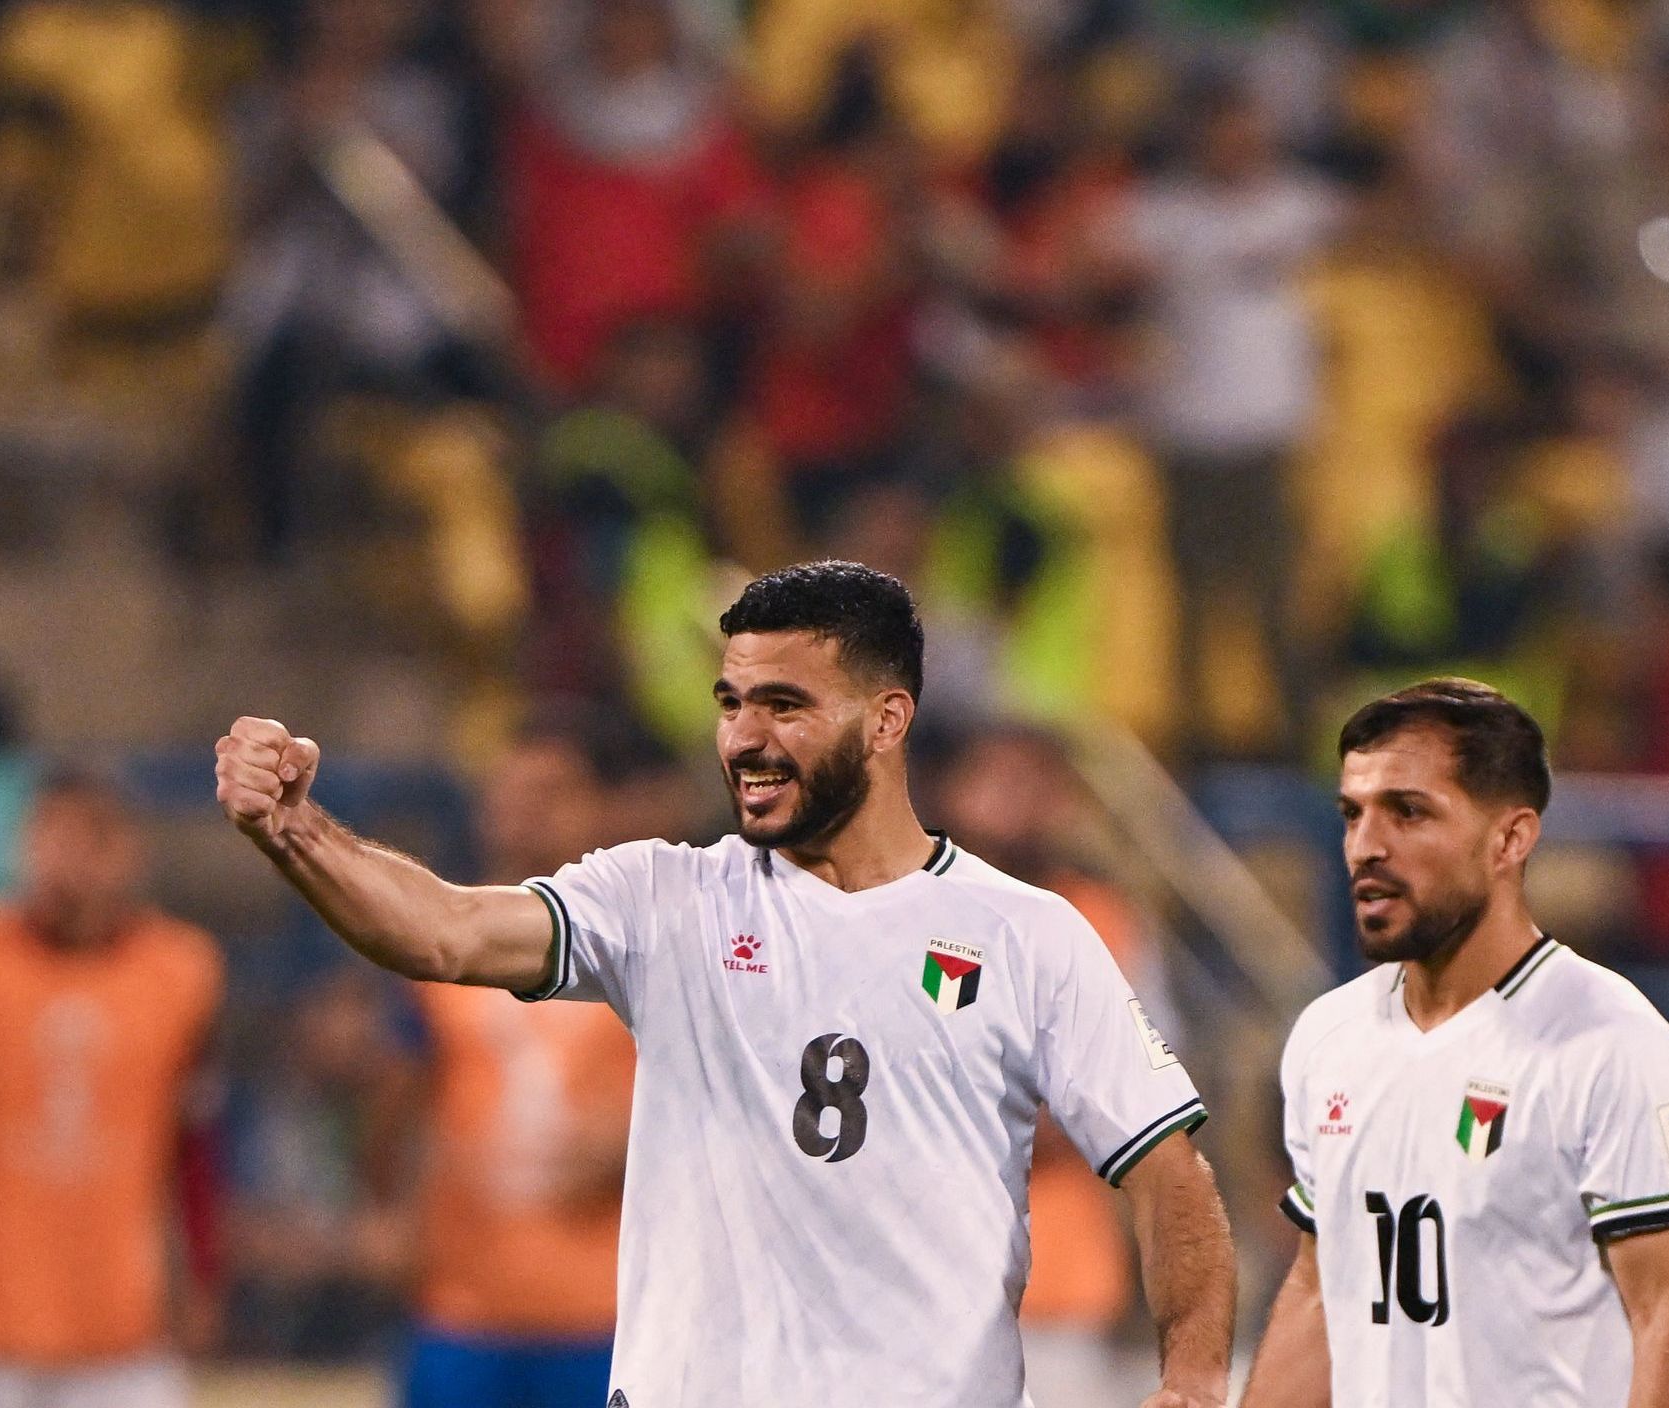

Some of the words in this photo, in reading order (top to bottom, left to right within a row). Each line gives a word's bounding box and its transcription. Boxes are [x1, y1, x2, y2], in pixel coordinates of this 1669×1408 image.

[930, 939, 983, 959] PALESTINE
[793, 1033, 870, 1163] 8
[1365, 1190, 1450, 1327] 10
